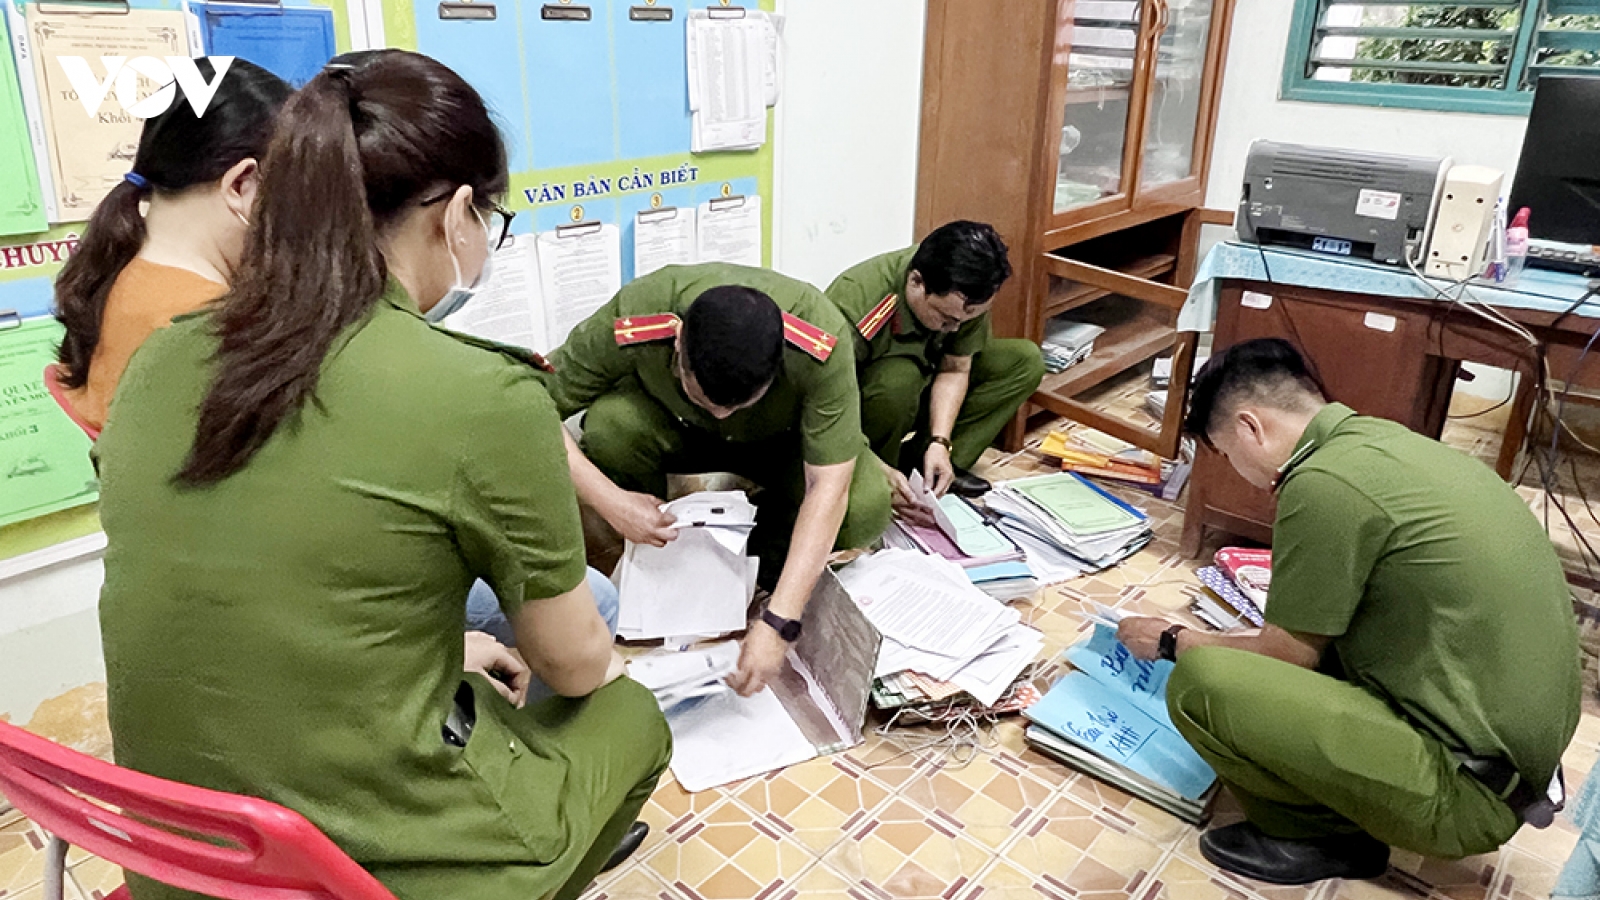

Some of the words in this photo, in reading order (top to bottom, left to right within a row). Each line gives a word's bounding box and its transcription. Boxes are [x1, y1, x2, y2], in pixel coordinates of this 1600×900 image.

[524, 183, 565, 204] VĂN
[573, 174, 611, 198] BẢN
[660, 162, 699, 185] BIẾT
[0, 233, 80, 268] HUYÊ
